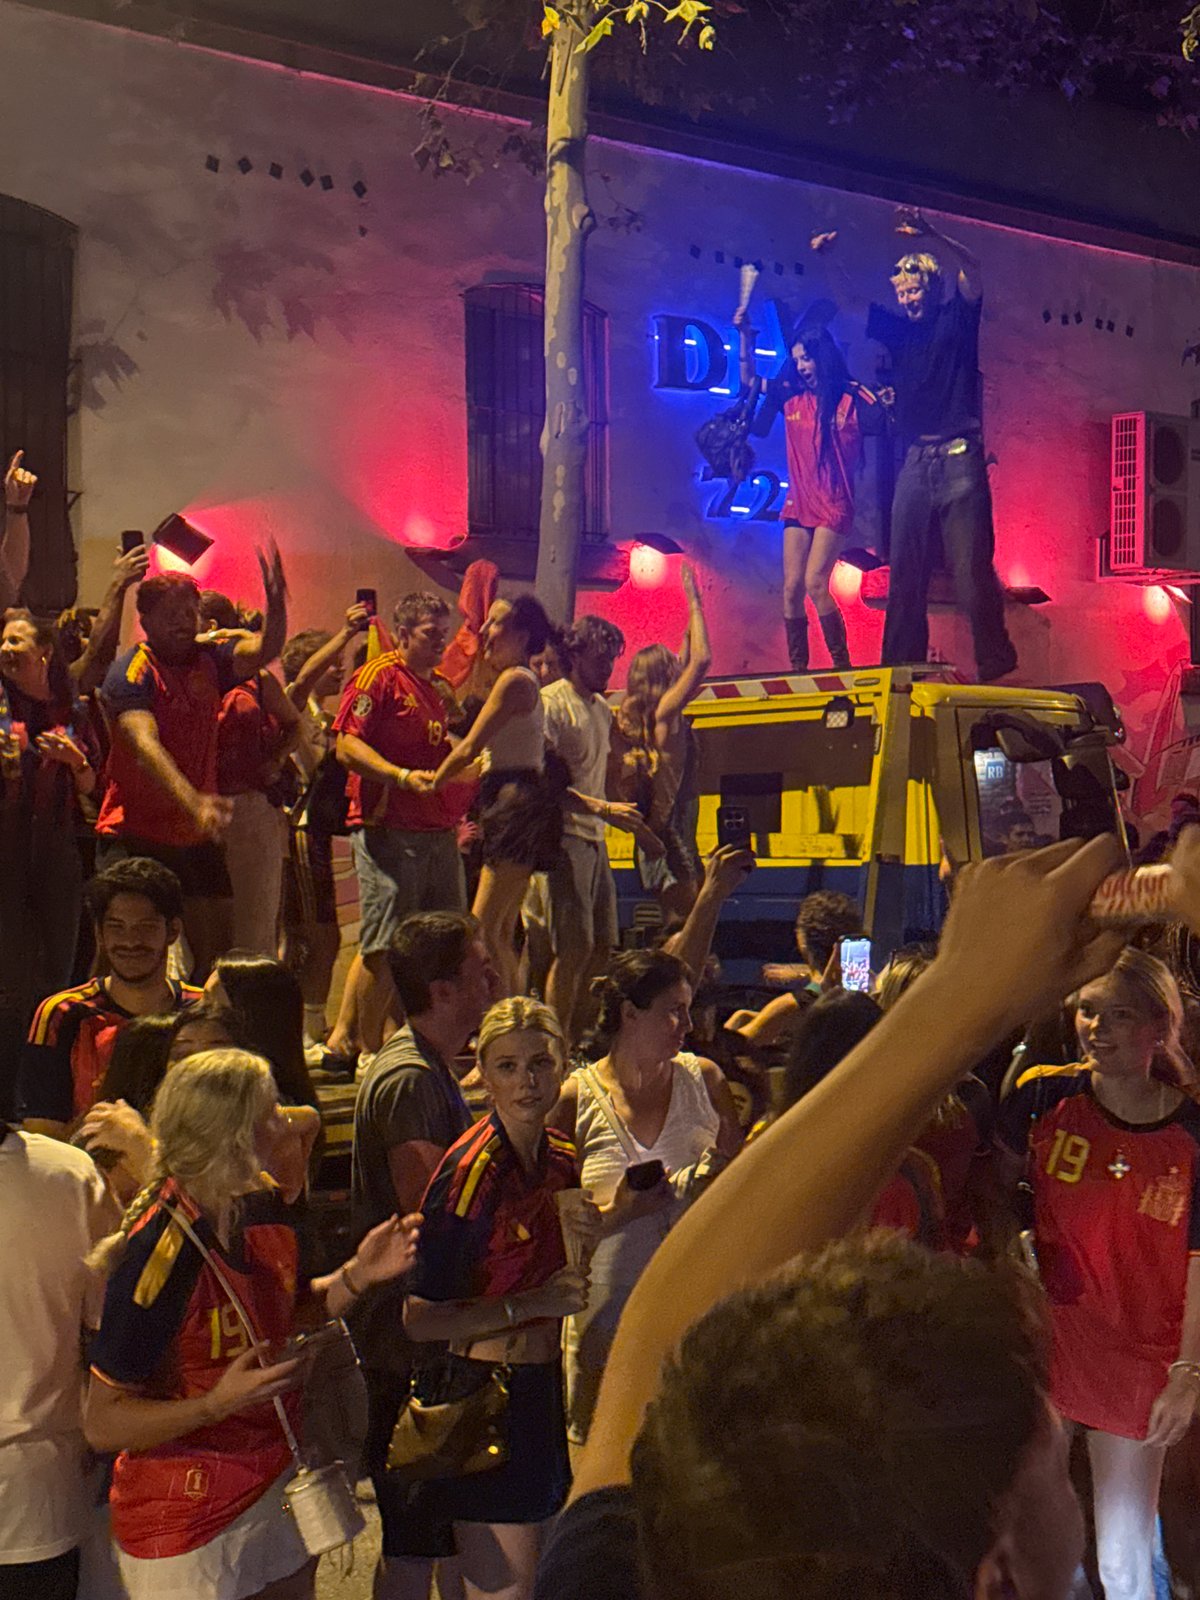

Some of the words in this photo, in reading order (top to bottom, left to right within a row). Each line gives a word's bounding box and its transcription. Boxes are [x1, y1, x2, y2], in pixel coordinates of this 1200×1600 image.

[428, 719, 443, 747] 19
[1046, 1128, 1091, 1183] 19
[207, 1303, 248, 1359] 19
